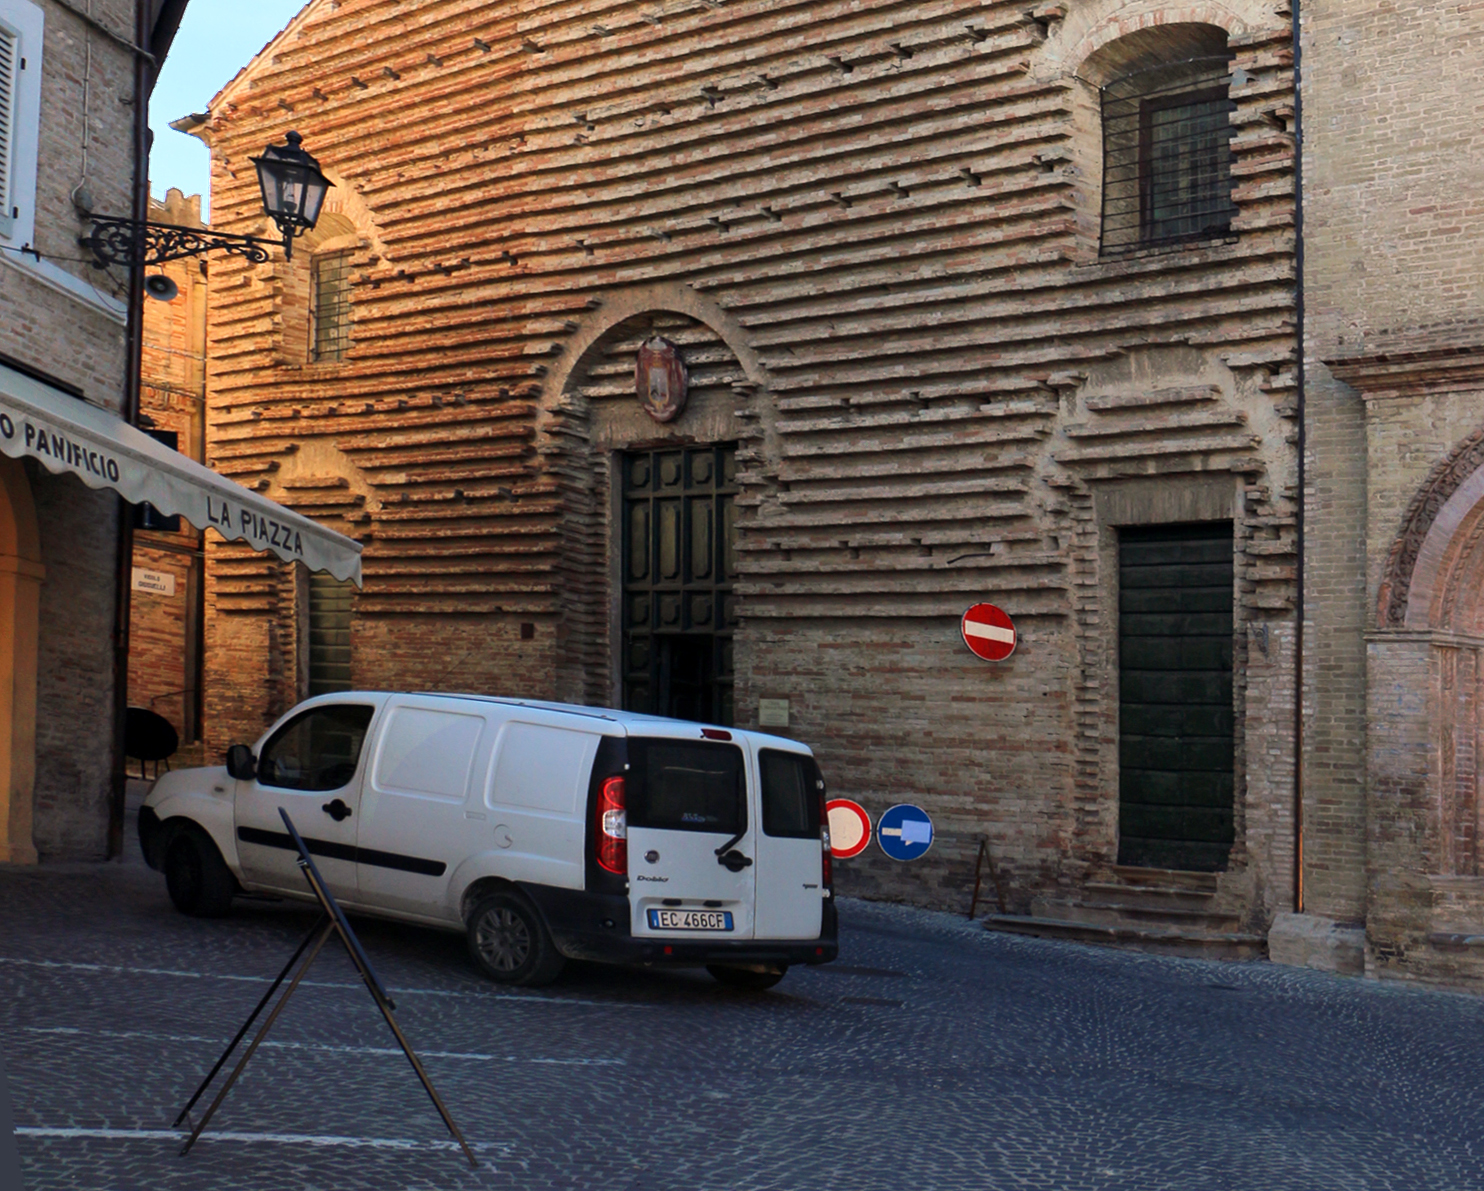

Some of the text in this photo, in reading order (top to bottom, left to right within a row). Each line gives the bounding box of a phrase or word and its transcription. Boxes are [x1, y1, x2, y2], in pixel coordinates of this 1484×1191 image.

[25, 422, 119, 483] PANIFICIO
[207, 496, 231, 529] LA
[241, 509, 304, 556] PIAZZA
[661, 912, 723, 928] EC 466CF
